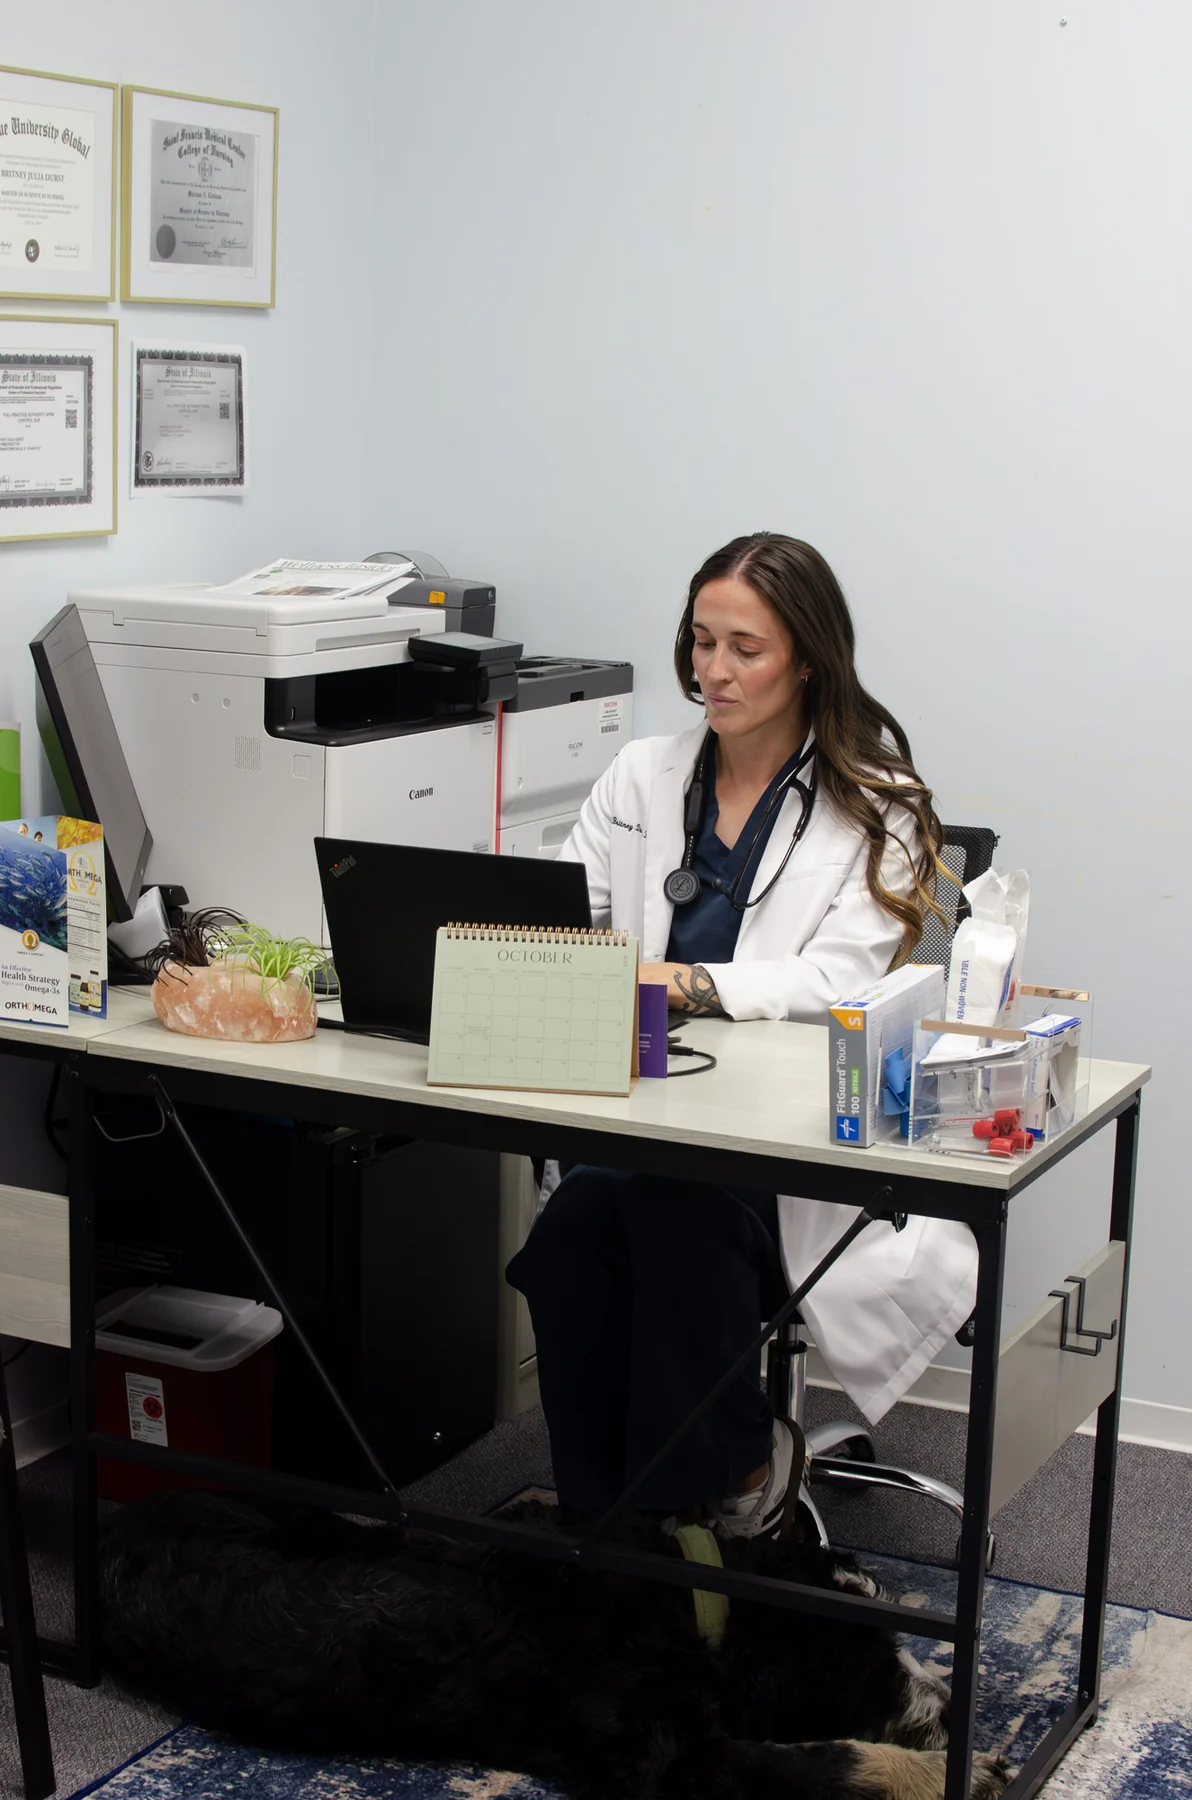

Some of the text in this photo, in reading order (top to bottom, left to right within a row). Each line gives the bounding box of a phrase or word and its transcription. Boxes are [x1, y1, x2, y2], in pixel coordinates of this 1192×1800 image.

[11, 117, 59, 144] University
[61, 128, 91, 159] Global
[163, 132, 179, 152] Saint
[180, 128, 203, 142] Francis
[204, 127, 227, 147] Medical
[178, 144, 233, 168] College of Nursing
[1, 169, 65, 183] BRITNEY JULIA DURST
[1, 370, 57, 384] State of Illinois
[165, 365, 212, 378] State of Illinois
[568, 741, 583, 750] RICOH
[408, 786, 434, 801] Canon
[611, 816, 634, 832] Britney
[497, 948, 573, 965] OCTOBER
[1, 970, 60, 987] Health Strategy
[25, 983, 60, 995] Omega-3s
[957, 977, 968, 1020] NON-WOVEN
[848, 1016, 861, 1027] S
[836, 1038, 847, 1113] FitGuard Touch
[850, 1068, 860, 1115] 100 NITRILE
